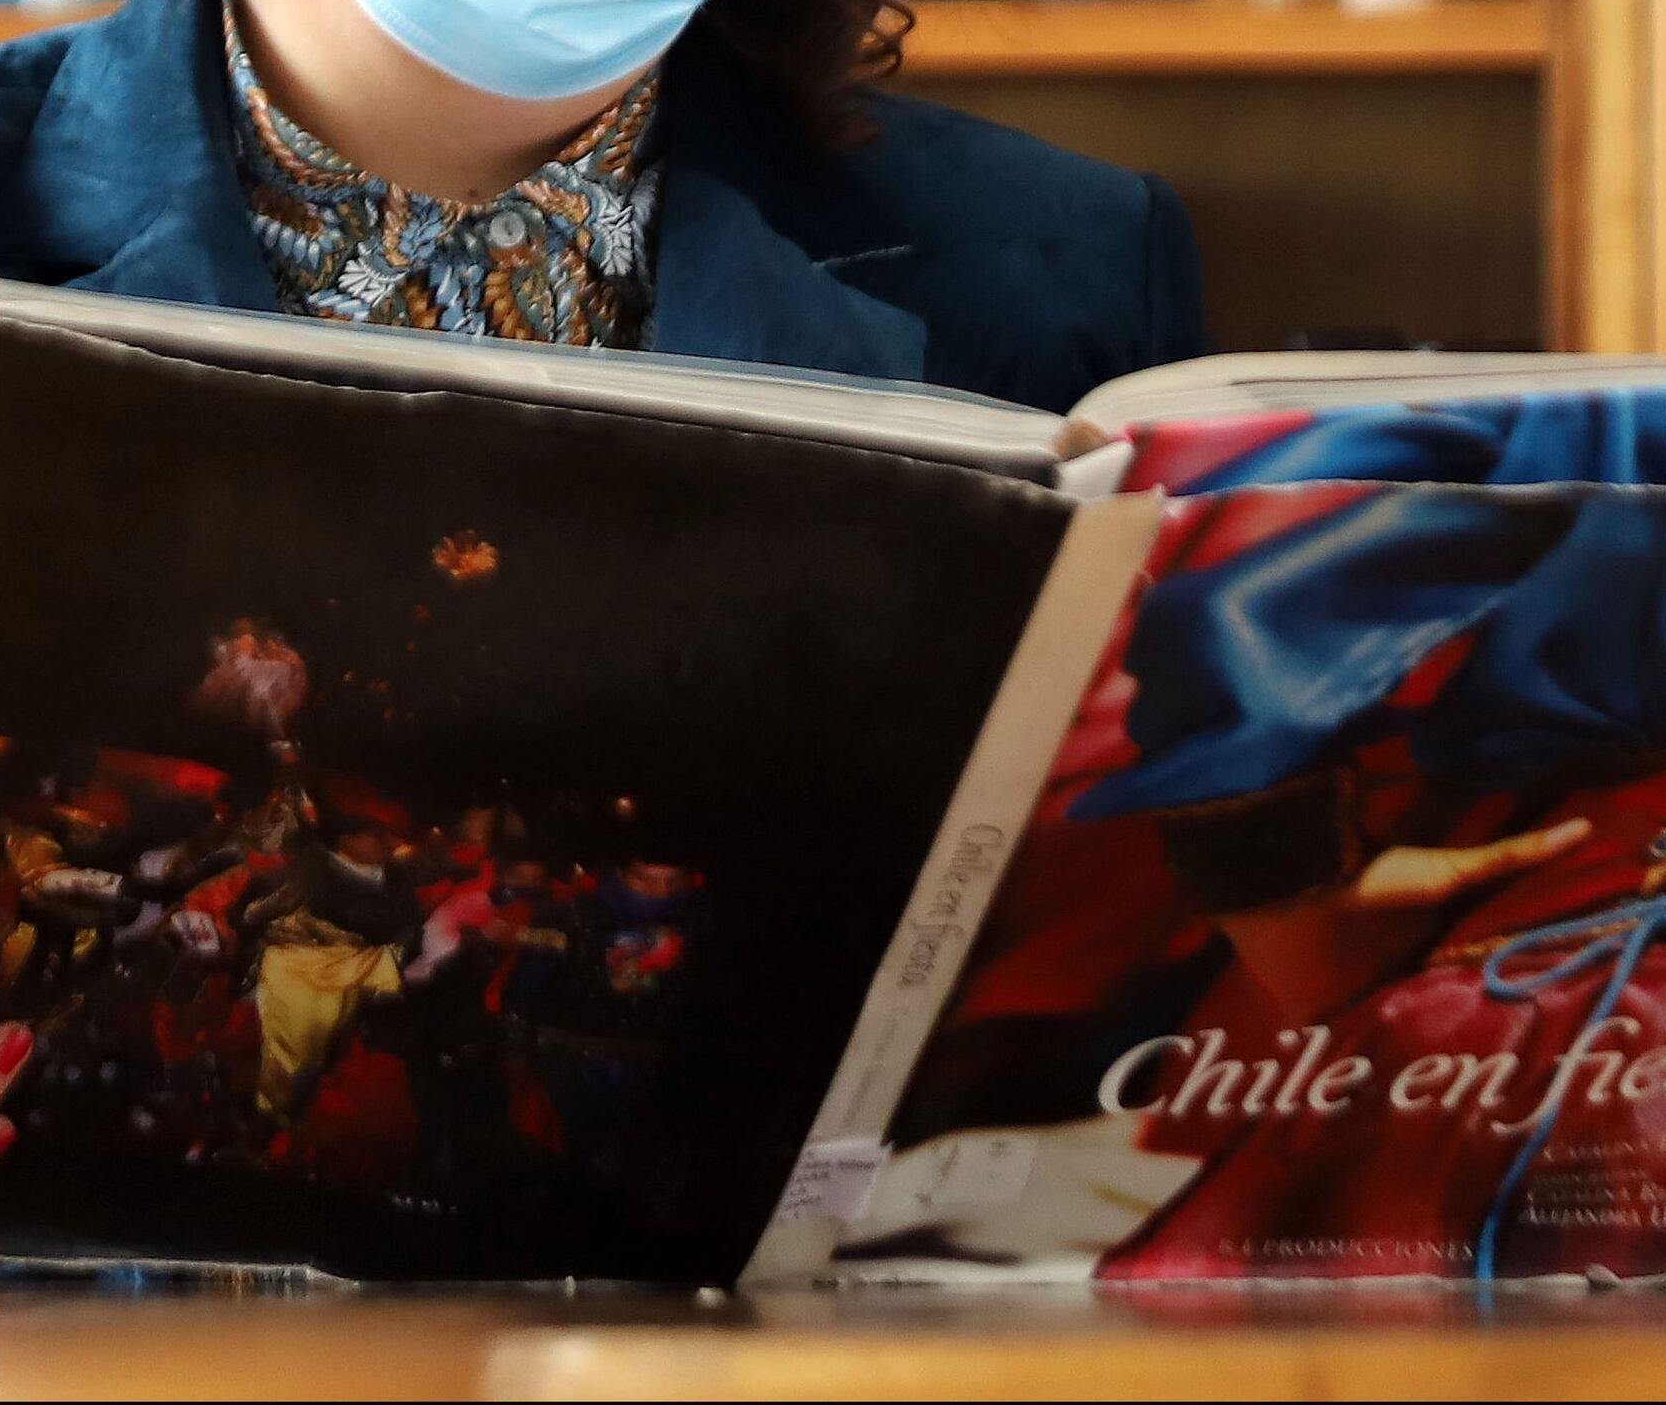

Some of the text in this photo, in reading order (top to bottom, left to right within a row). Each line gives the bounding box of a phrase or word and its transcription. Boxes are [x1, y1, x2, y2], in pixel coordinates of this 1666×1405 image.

[946, 822, 1005, 887] Chile
[1097, 1024, 1371, 1119] Chile
[1389, 1048, 1525, 1114] en
